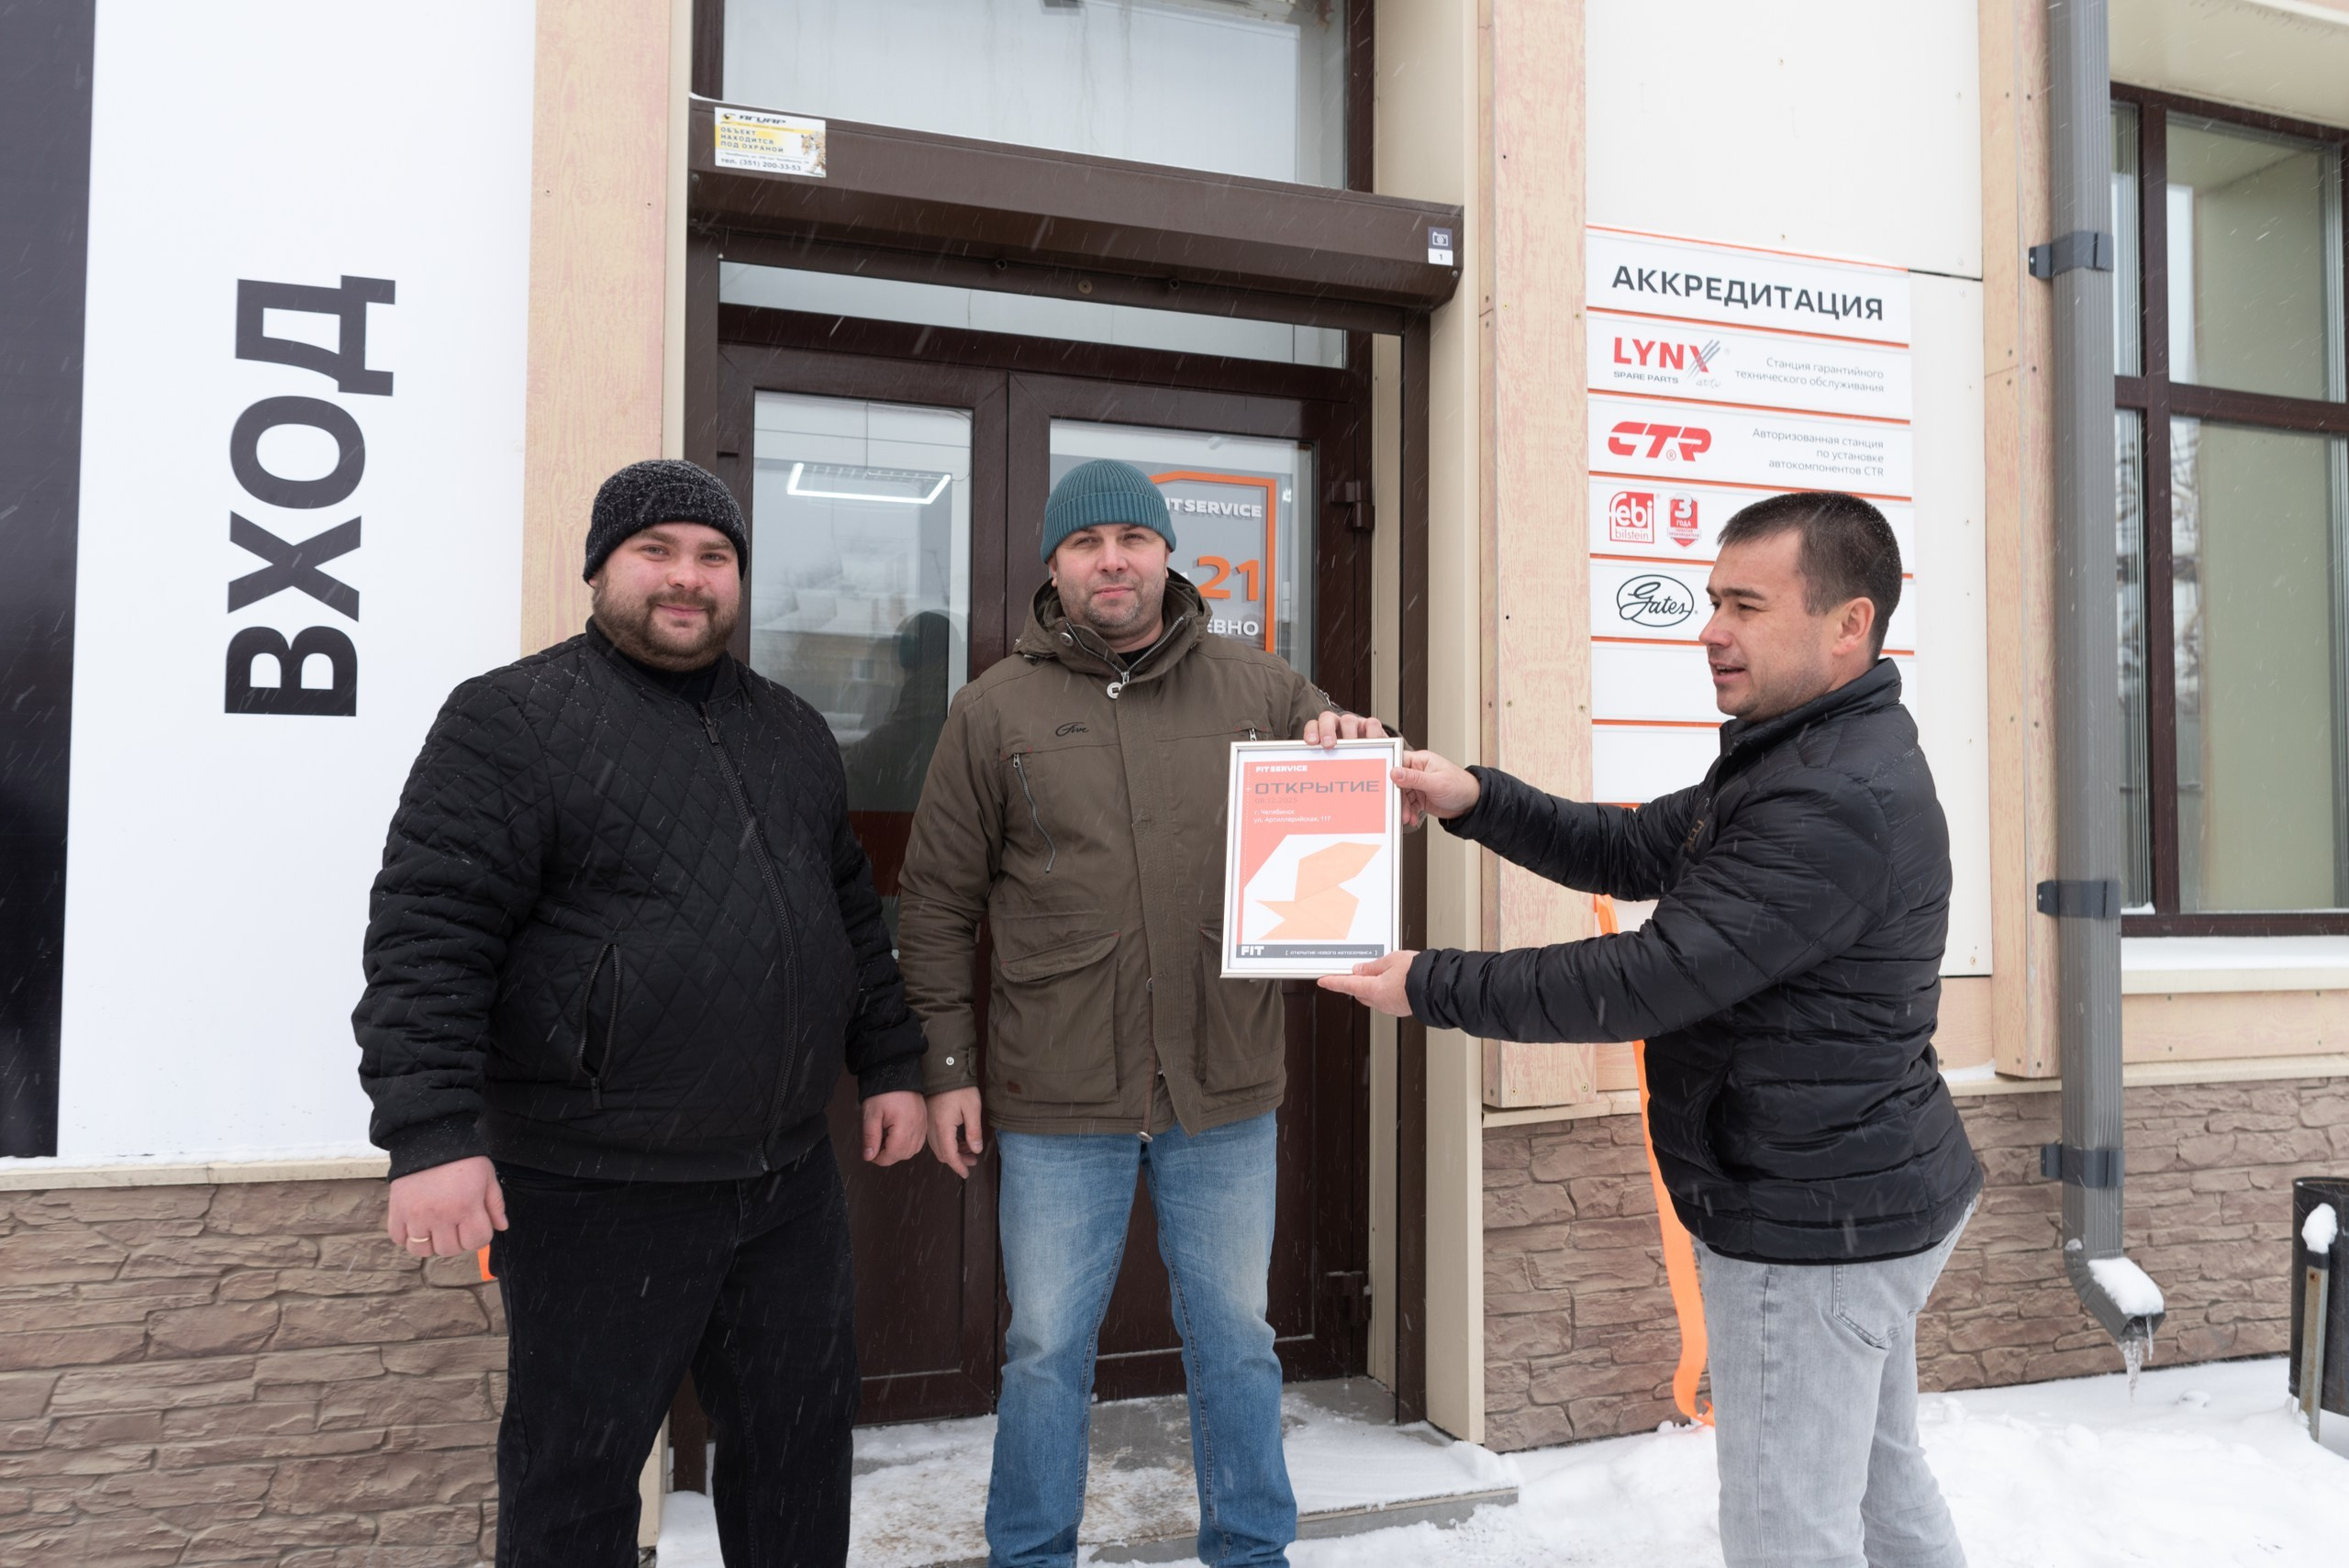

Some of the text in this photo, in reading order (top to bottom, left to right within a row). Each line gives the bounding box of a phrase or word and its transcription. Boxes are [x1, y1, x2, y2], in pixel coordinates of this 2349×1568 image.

[720, 127, 756, 136] ОБЪЕКТ
[720, 134, 774, 145] НАХОДИТСЯ
[740, 159, 761, 167] (351)
[763, 161, 801, 172] 200-33-53
[1611, 265, 1883, 321] АККРЕДИТАЦИЯ
[1613, 337, 1721, 377] LYNX
[1613, 371, 1679, 384] SPARE PARTS
[1766, 357, 1884, 379] Станция гарантийного
[1735, 370, 1884, 393] технического обслуживания
[1608, 421, 1712, 462] CTR
[1753, 428, 1884, 449] Авторизованная станция
[1816, 449, 1884, 463] по установке
[1768, 459, 1885, 477] автокомпонентов CTR
[224, 274, 395, 717] ВХОД
[1675, 492, 1694, 519] 3
[1164, 496, 1263, 518] IT SERVICE
[1610, 492, 1653, 528] febi
[1615, 528, 1649, 540] bilstein
[1675, 519, 1692, 528] ГОДА
[1197, 554, 1260, 602] 21
[1620, 581, 1691, 620] Gates
[1255, 764, 1308, 773] FIT SERVICE
[1254, 780, 1380, 795] ОТКРЫТИЕ
[1241, 945, 1264, 956] FIT
